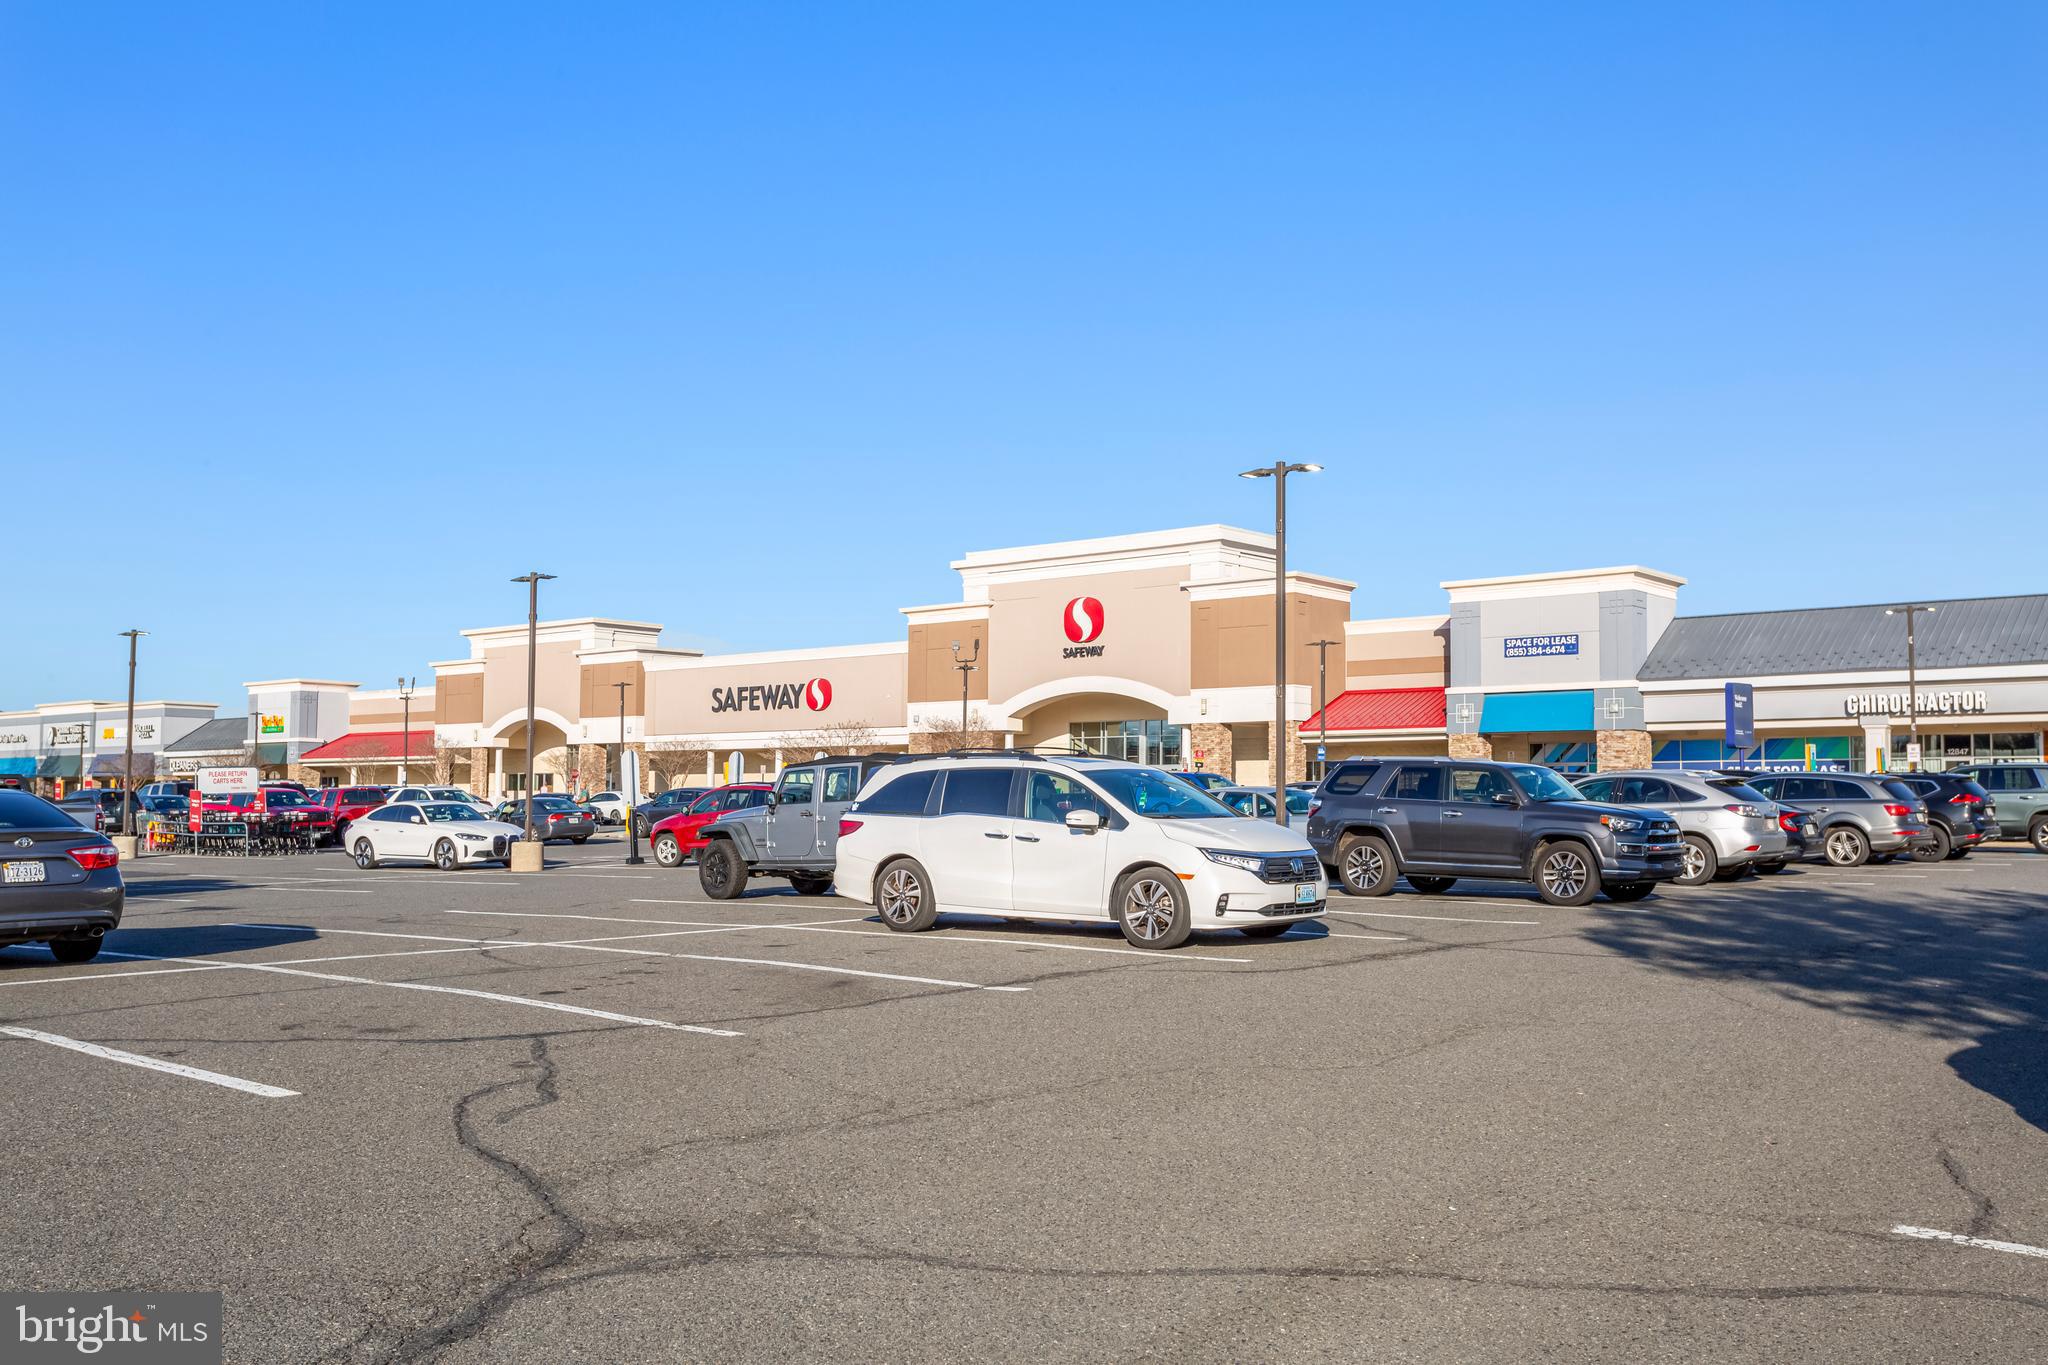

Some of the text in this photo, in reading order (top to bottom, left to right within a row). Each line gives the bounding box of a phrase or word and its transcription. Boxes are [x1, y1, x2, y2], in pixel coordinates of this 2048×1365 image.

[1506, 635, 1577, 648] SPACE FOR LEASE
[1062, 645, 1105, 659] SAFEWAY
[1506, 647, 1527, 657] (855)
[1527, 645, 1566, 656] 384-6474
[711, 683, 806, 713] SAFEWAY
[1845, 690, 1988, 716] CHIROPRACTOR
[1946, 747, 1969, 756] 12847
